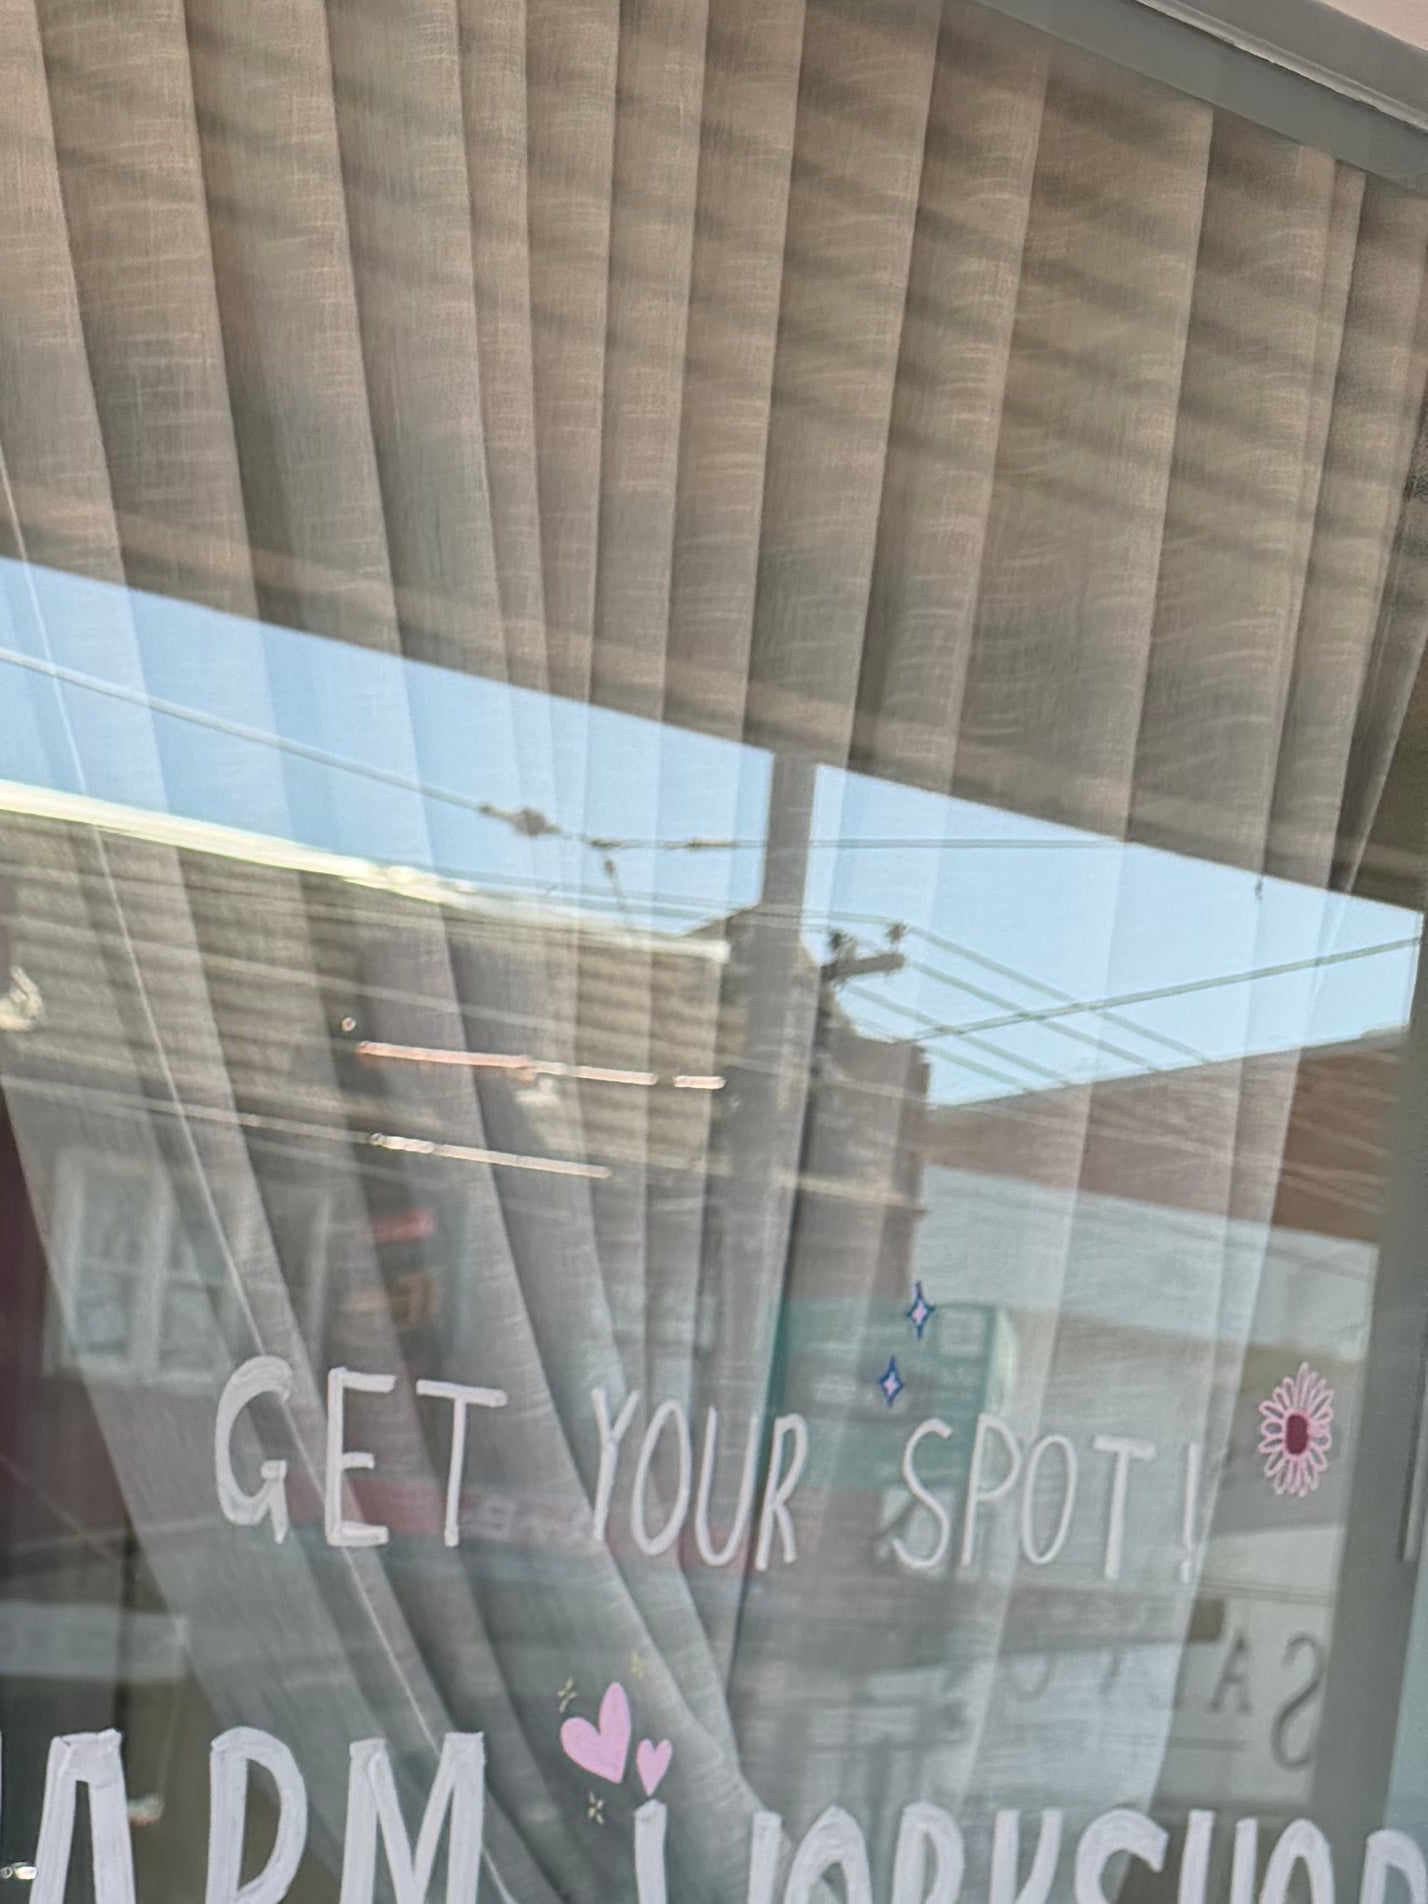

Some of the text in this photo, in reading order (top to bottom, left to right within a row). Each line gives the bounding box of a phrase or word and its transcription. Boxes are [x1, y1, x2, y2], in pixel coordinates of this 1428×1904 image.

[216, 1357, 1199, 1580] GET YOUR SPOT!
